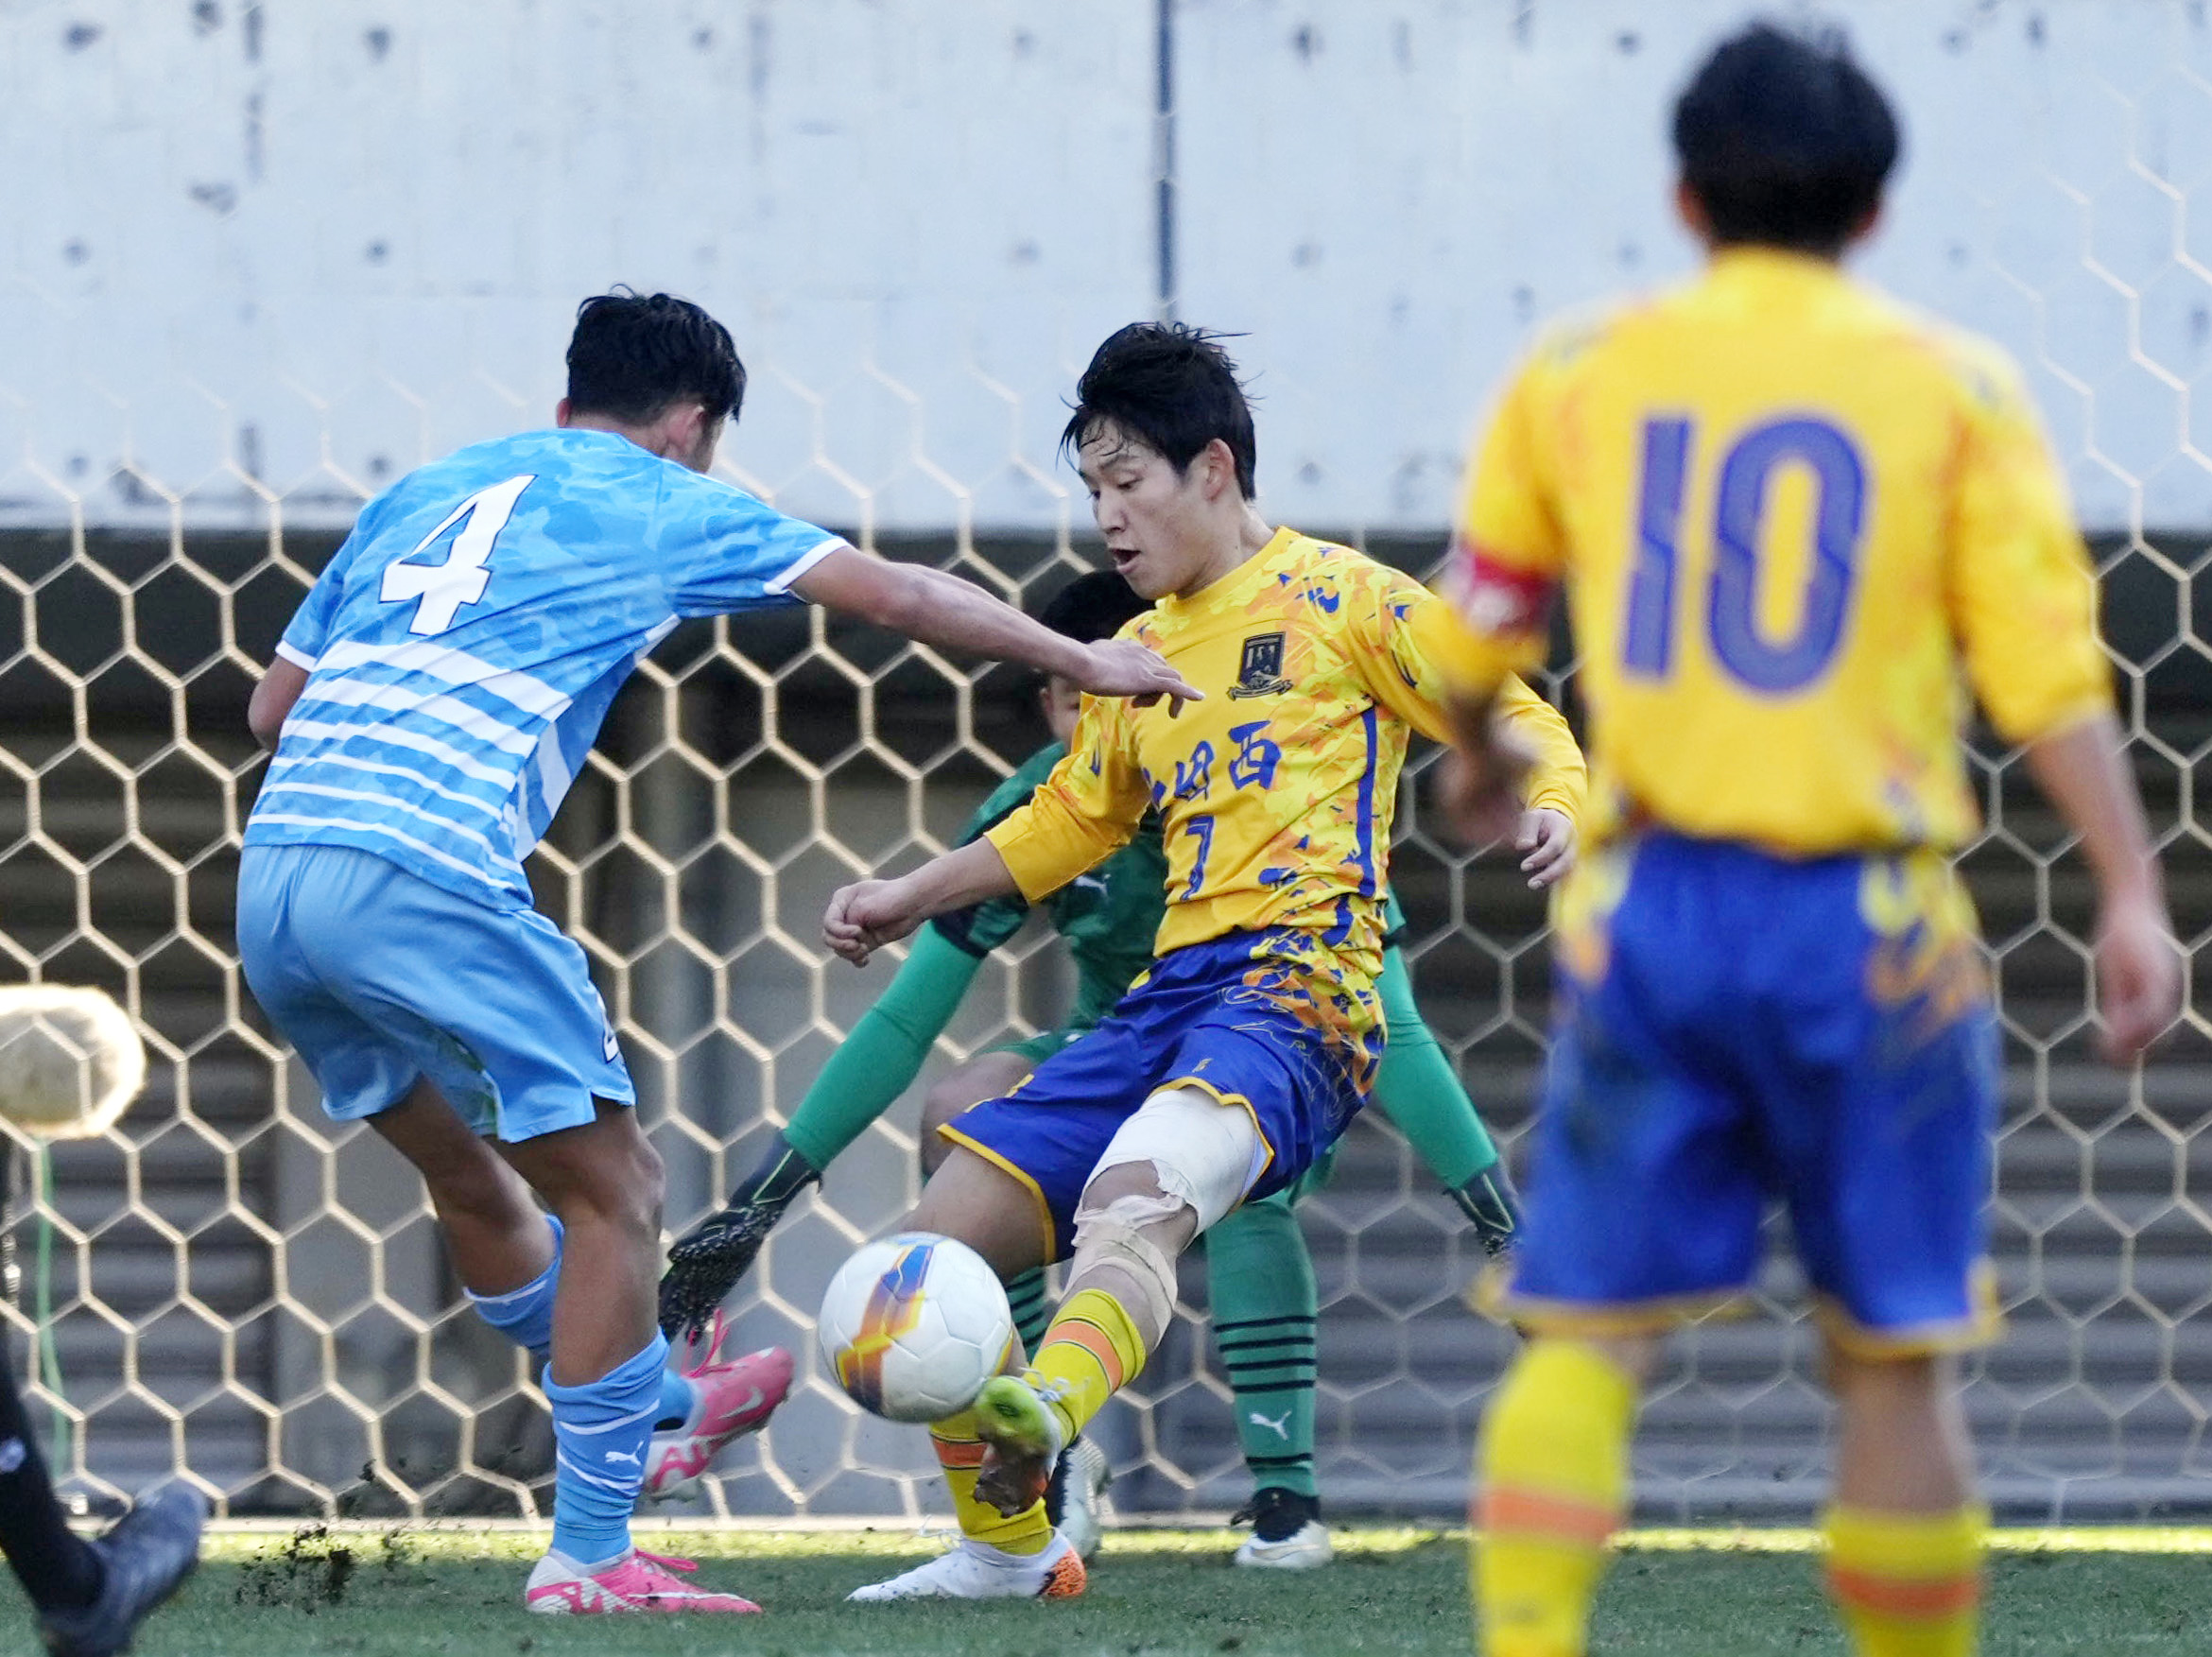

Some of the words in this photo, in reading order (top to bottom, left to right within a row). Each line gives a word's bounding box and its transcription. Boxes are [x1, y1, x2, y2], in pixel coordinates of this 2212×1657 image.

[378, 474, 538, 636] 4
[1621, 416, 1866, 693] 10
[1181, 816, 1214, 901] 7
